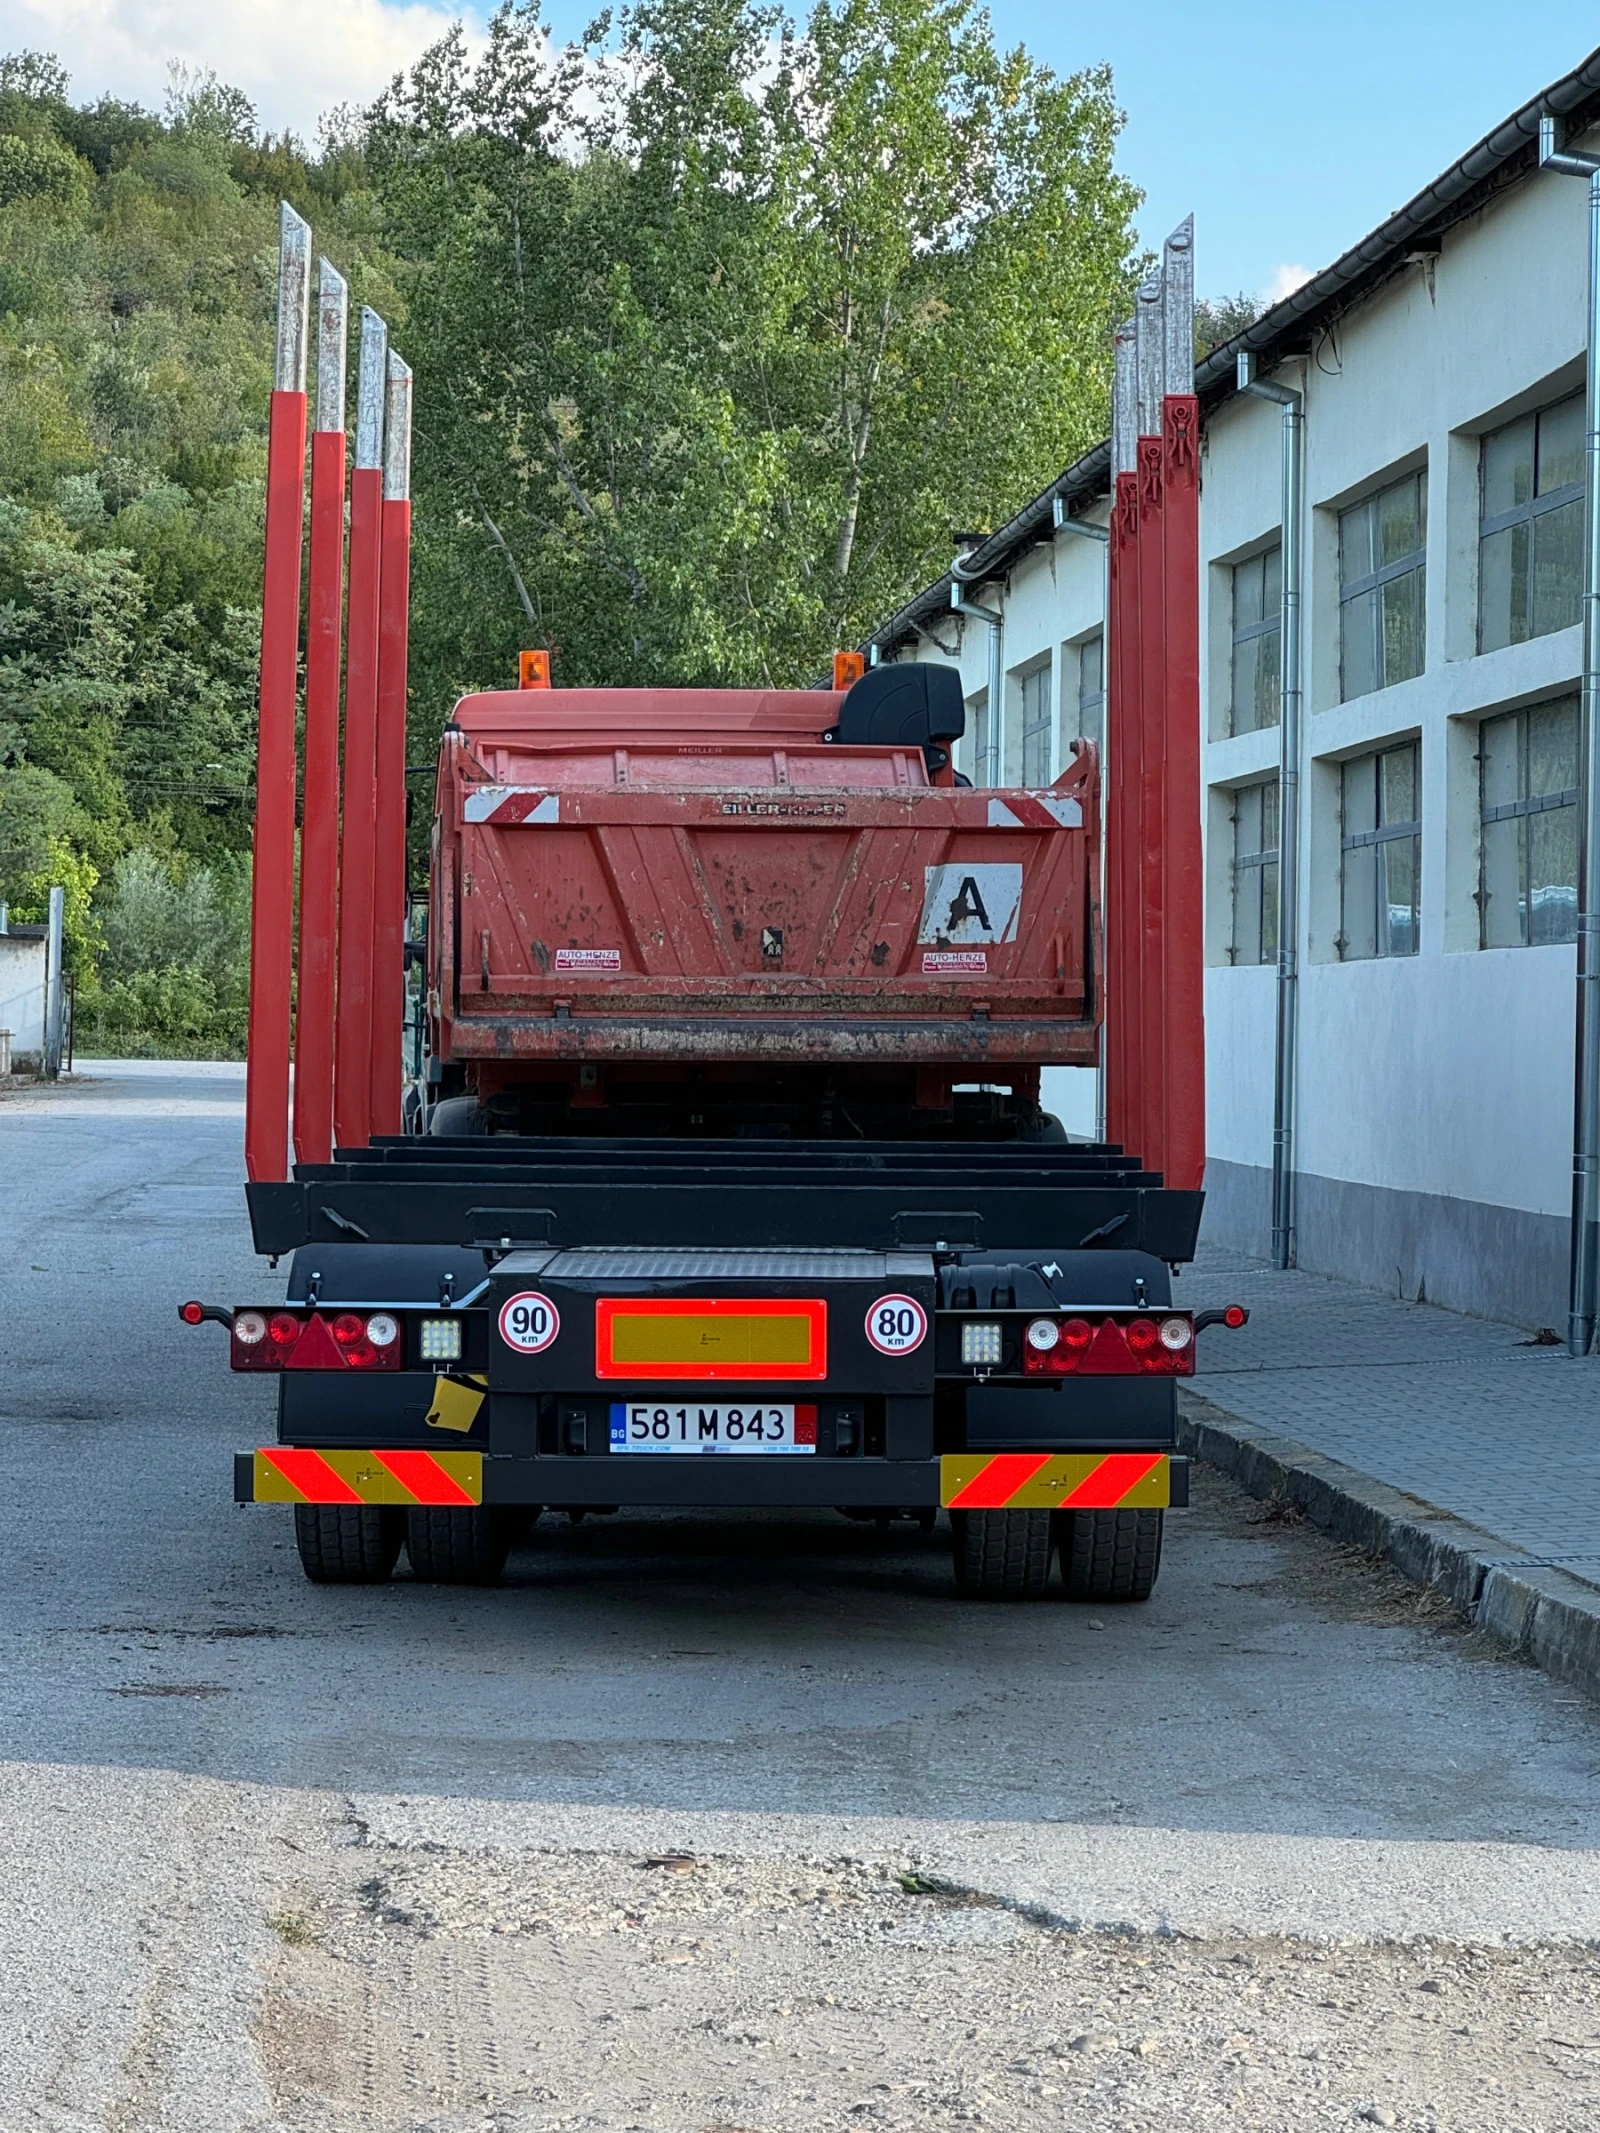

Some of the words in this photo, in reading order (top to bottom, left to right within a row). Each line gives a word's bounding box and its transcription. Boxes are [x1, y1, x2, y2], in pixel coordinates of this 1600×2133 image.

[678, 746, 723, 755] MEILLER
[946, 876, 993, 931] A
[558, 950, 619, 960] AUTO-HENZE
[924, 953, 985, 962] AUTO-HENZE
[512, 1305, 548, 1335] 90
[878, 1308, 915, 1337] 80
[611, 1429, 625, 1439] BG
